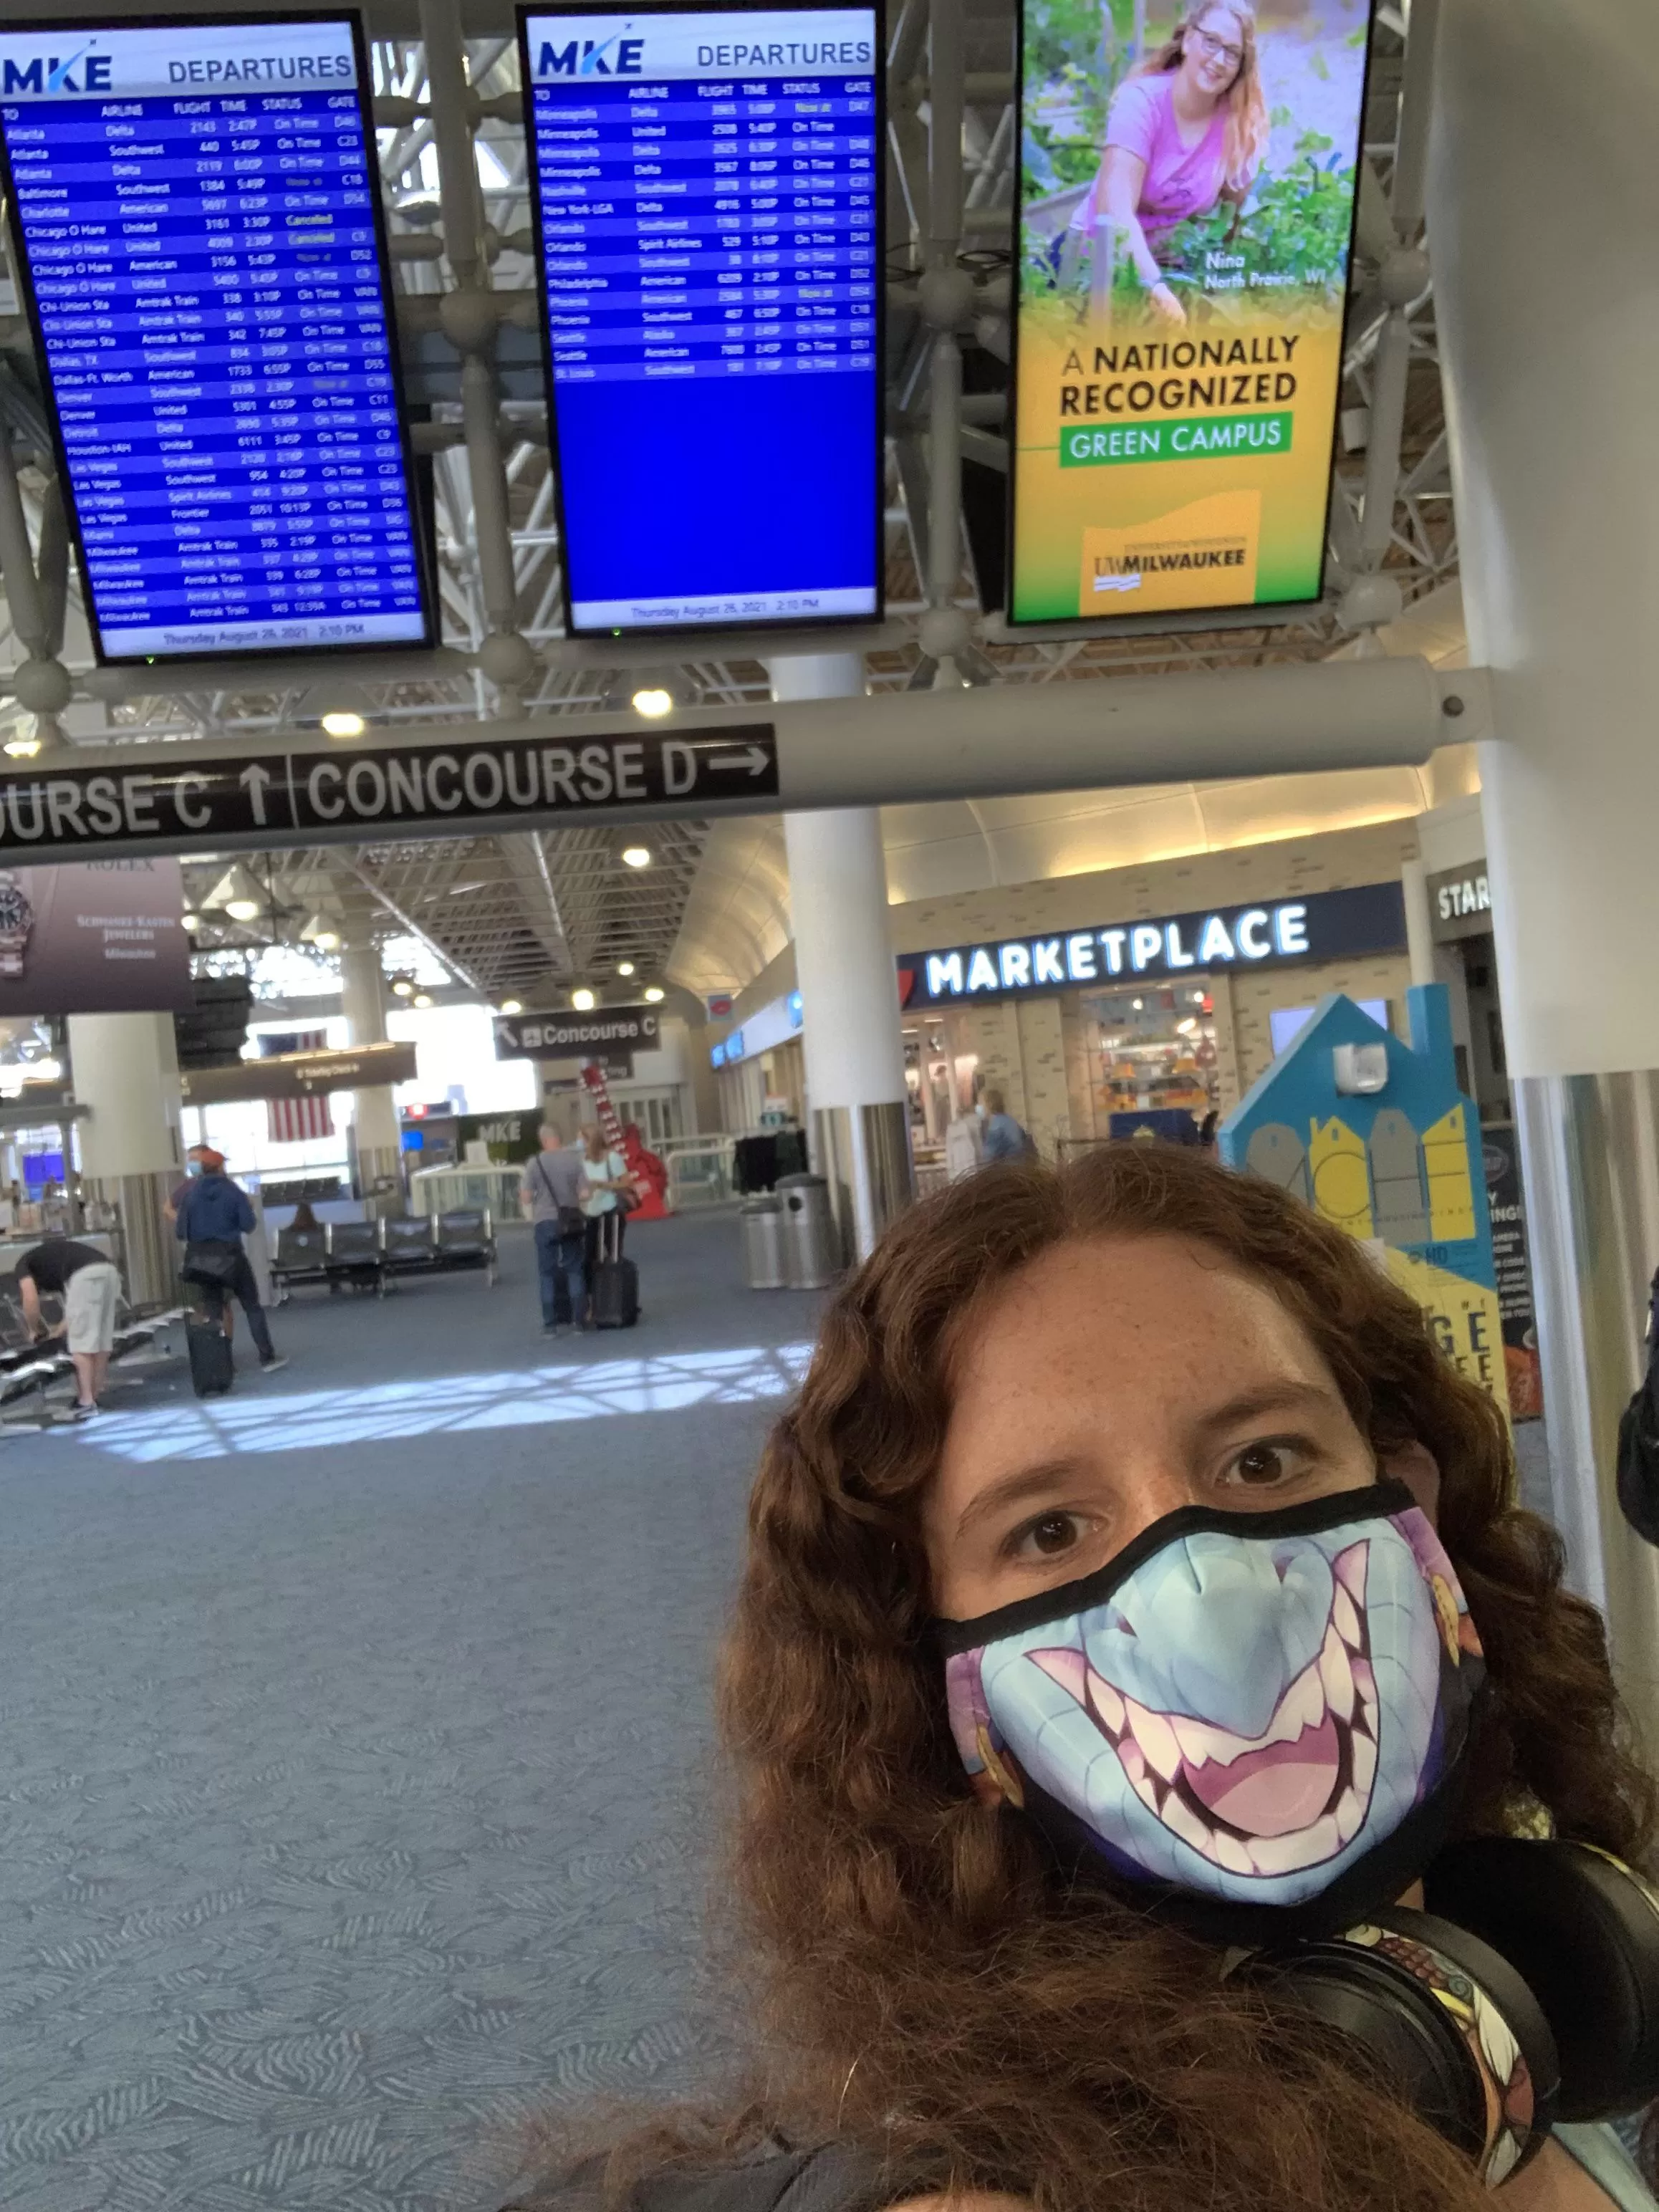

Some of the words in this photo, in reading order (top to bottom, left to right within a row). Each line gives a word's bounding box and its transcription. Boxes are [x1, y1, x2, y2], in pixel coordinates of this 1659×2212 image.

[539, 39, 645, 75] MKE
[698, 42, 871, 67] DEPARTURES
[3, 54, 112, 95] MKE
[169, 55, 352, 84] DEPARTURES
[627, 86, 668, 98] AIRLINE
[697, 84, 734, 97] FLIGHT
[741, 83, 768, 95] TIME
[782, 82, 820, 95] STATUS
[844, 81, 870, 93] GATE
[1, 107, 19, 120] TO
[100, 103, 143, 117] AIRLINE
[173, 100, 211, 114] FLIGHT
[219, 99, 246, 112] TIME
[261, 97, 302, 110] STATUS
[327, 95, 355, 108] GATE
[105, 124, 135, 137] Delta
[108, 143, 165, 156] Southwest
[276, 137, 294, 149] On
[294, 137, 321, 148] Time
[111, 163, 141, 176] Delta
[115, 183, 170, 196] Southwest
[24, 226, 68, 238] Chicago
[122, 221, 158, 234] United
[27, 244, 72, 257] Chicago
[1206, 251, 1246, 269] Nina
[32, 264, 74, 276] Chicago
[1205, 271, 1246, 289] North
[1062, 350, 1085, 376] A
[1094, 335, 1300, 375] NATIONALLY
[1060, 372, 1297, 416] RECOGNIZED
[1069, 428, 1160, 459] GREEN
[1171, 420, 1281, 453] CAMPUS
[308, 743, 647, 820] CONCOURSE
[661, 741, 697, 795] D
[0, 774, 160, 840] URSE
[174, 771, 213, 829] C
[1438, 876, 1491, 920] STAR
[925, 903, 1310, 997] MARKETPLACE
[543, 1021, 638, 1045] Concourse
[642, 1016, 656, 1037] C
[478, 1120, 522, 1143] MKE
